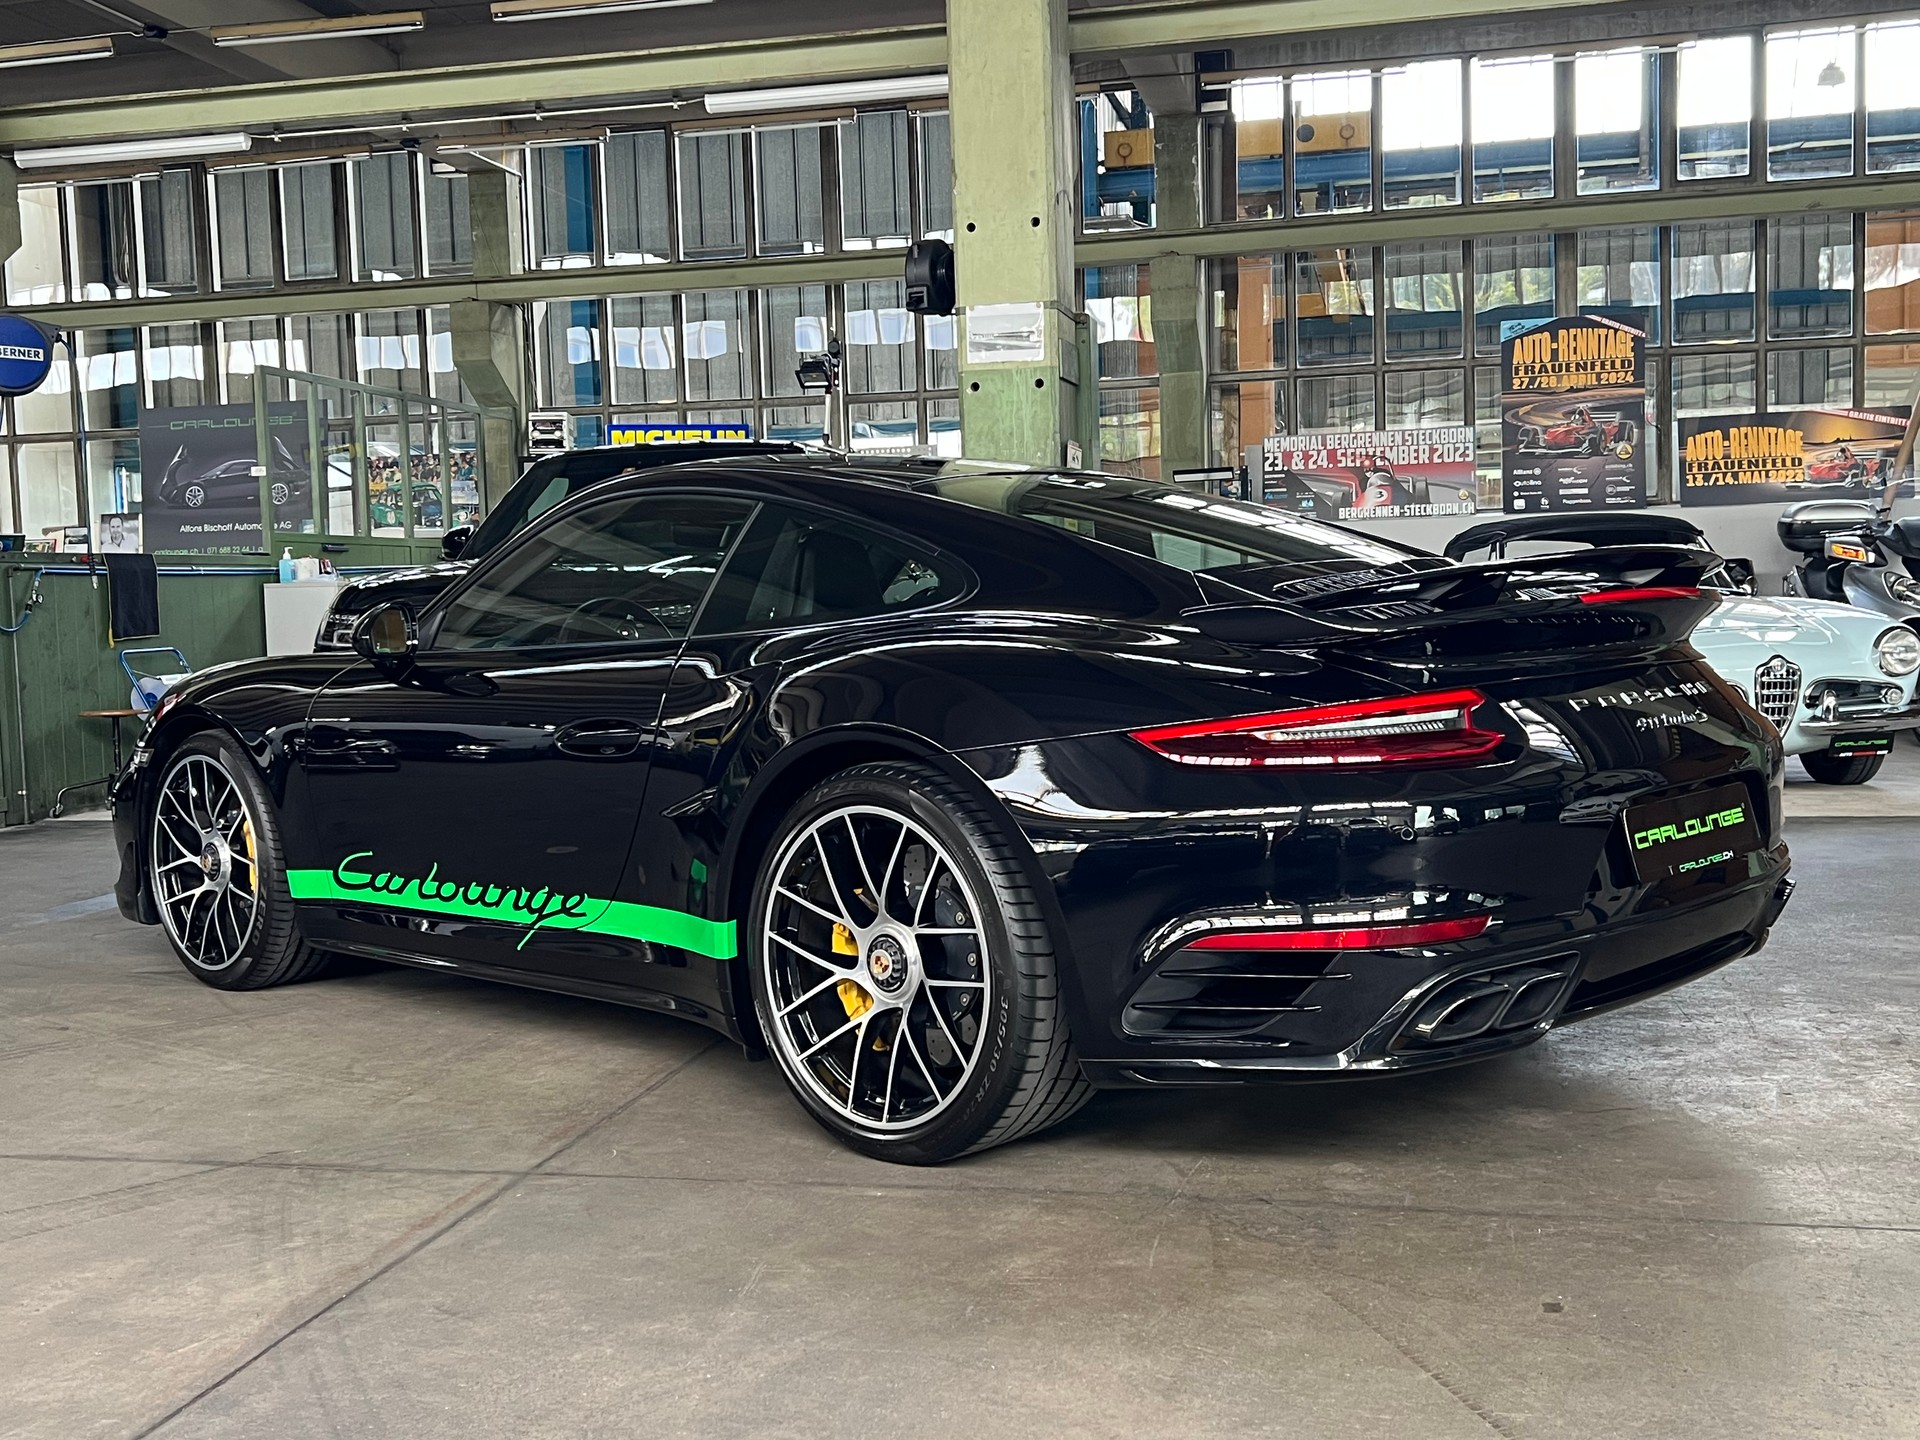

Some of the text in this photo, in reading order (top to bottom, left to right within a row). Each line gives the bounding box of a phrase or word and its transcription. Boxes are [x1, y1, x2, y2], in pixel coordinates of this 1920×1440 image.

[1513, 328, 1634, 364] AUTO-RENNTAGE
[1513, 359, 1634, 377] FRAUENFELD
[1600, 371, 1634, 384] 2024
[1849, 410, 1907, 427] GRATIS EINTRITT
[1264, 426, 1474, 453] MEMORIAL BERGRENNEN STECKBORN
[1686, 427, 1804, 461] AUTO-RENNTAGE
[1264, 452, 1288, 471] 23.
[1291, 451, 1305, 470] &
[1308, 449, 1333, 470] 24.
[1433, 442, 1474, 464] 2023
[1686, 456, 1803, 473] FRAUENFELD
[1768, 469, 1805, 483] 2023
[1338, 502, 1475, 519] BERGRENNEN-STECKBORN.CH
[180, 524, 202, 533] Alfons
[203, 523, 232, 532] Bischoff
[280, 520, 292, 529] AG
[1634, 807, 1745, 850] CARLOUNGE
[1679, 850, 1734, 873] CARLOUNGE.CH
[332, 851, 588, 951] Carlounge
